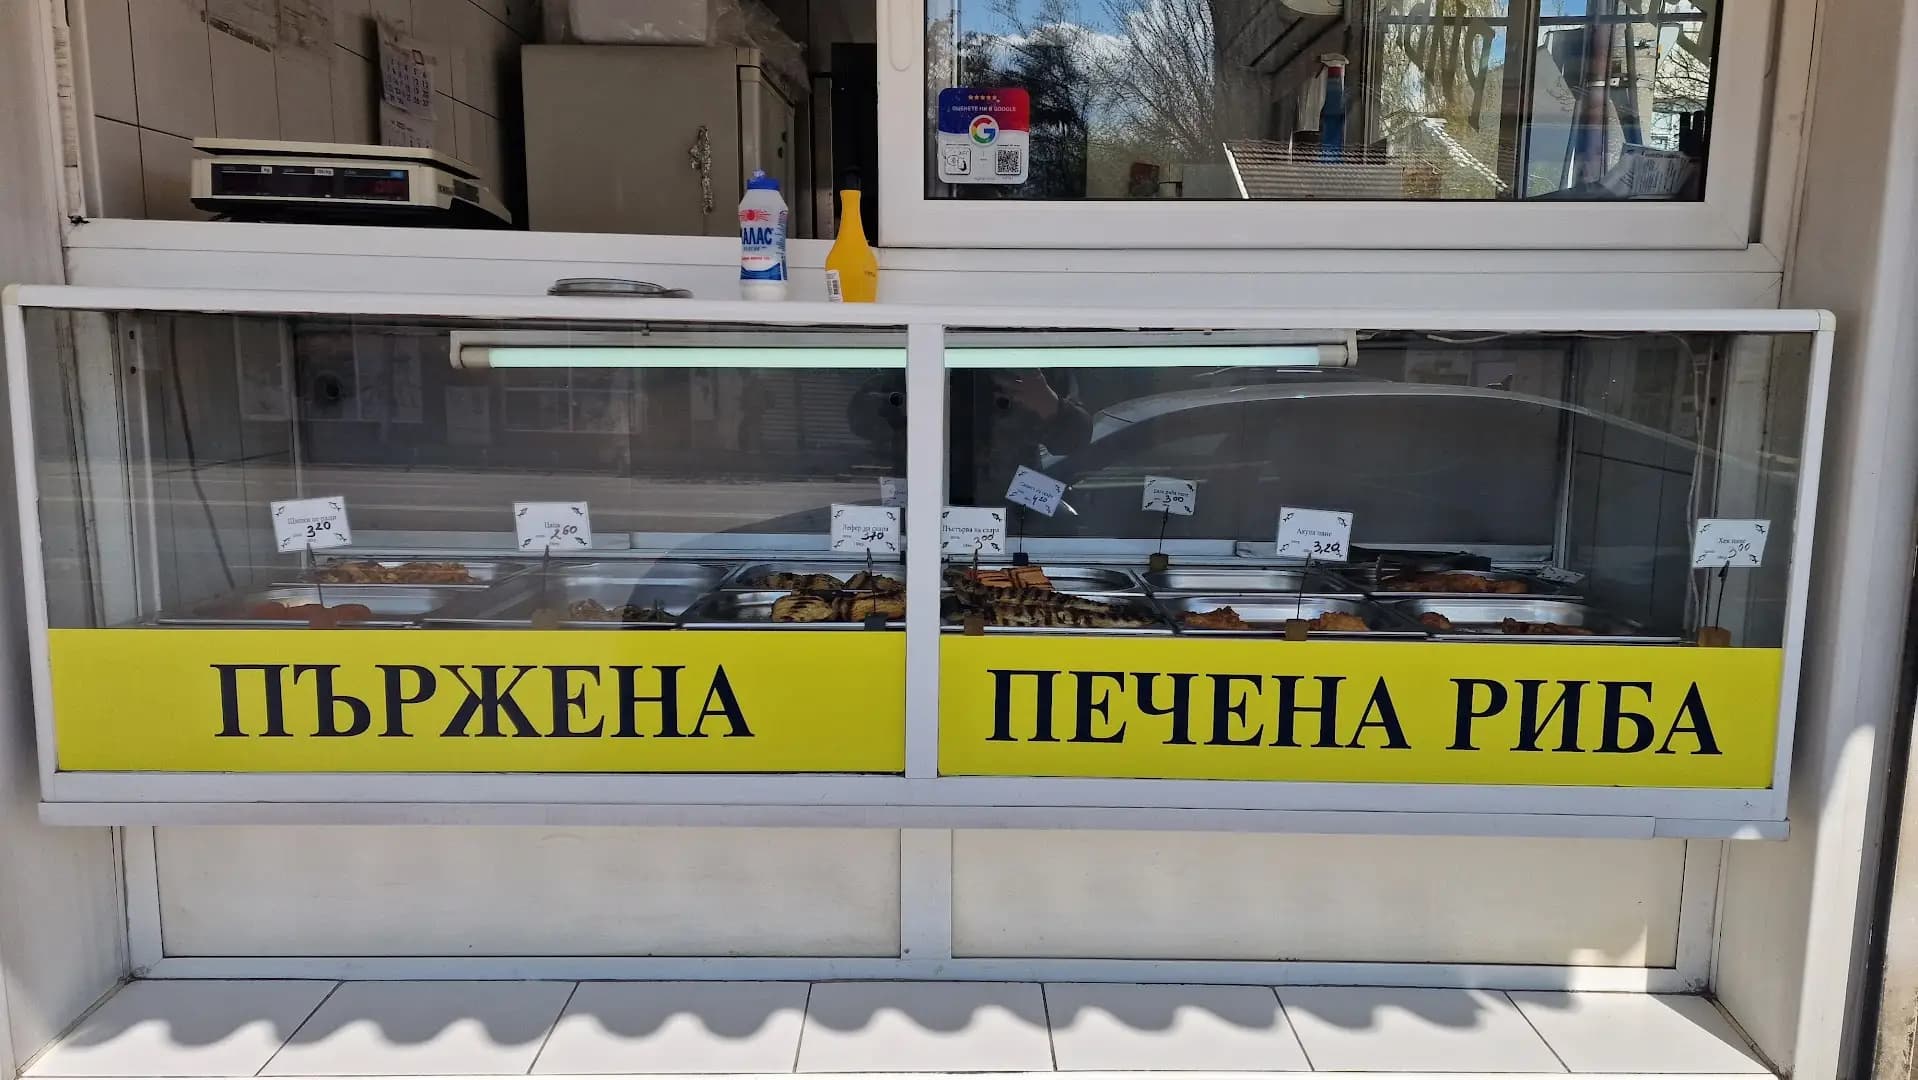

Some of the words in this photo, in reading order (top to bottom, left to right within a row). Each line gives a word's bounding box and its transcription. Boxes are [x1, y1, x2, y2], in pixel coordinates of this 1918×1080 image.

[742, 227, 772, 245] АЛАС
[209, 663, 756, 738] ПЪРЖЕНА
[984, 668, 1412, 750] ПЕЧЕНА
[1445, 676, 1723, 756] РИБА
